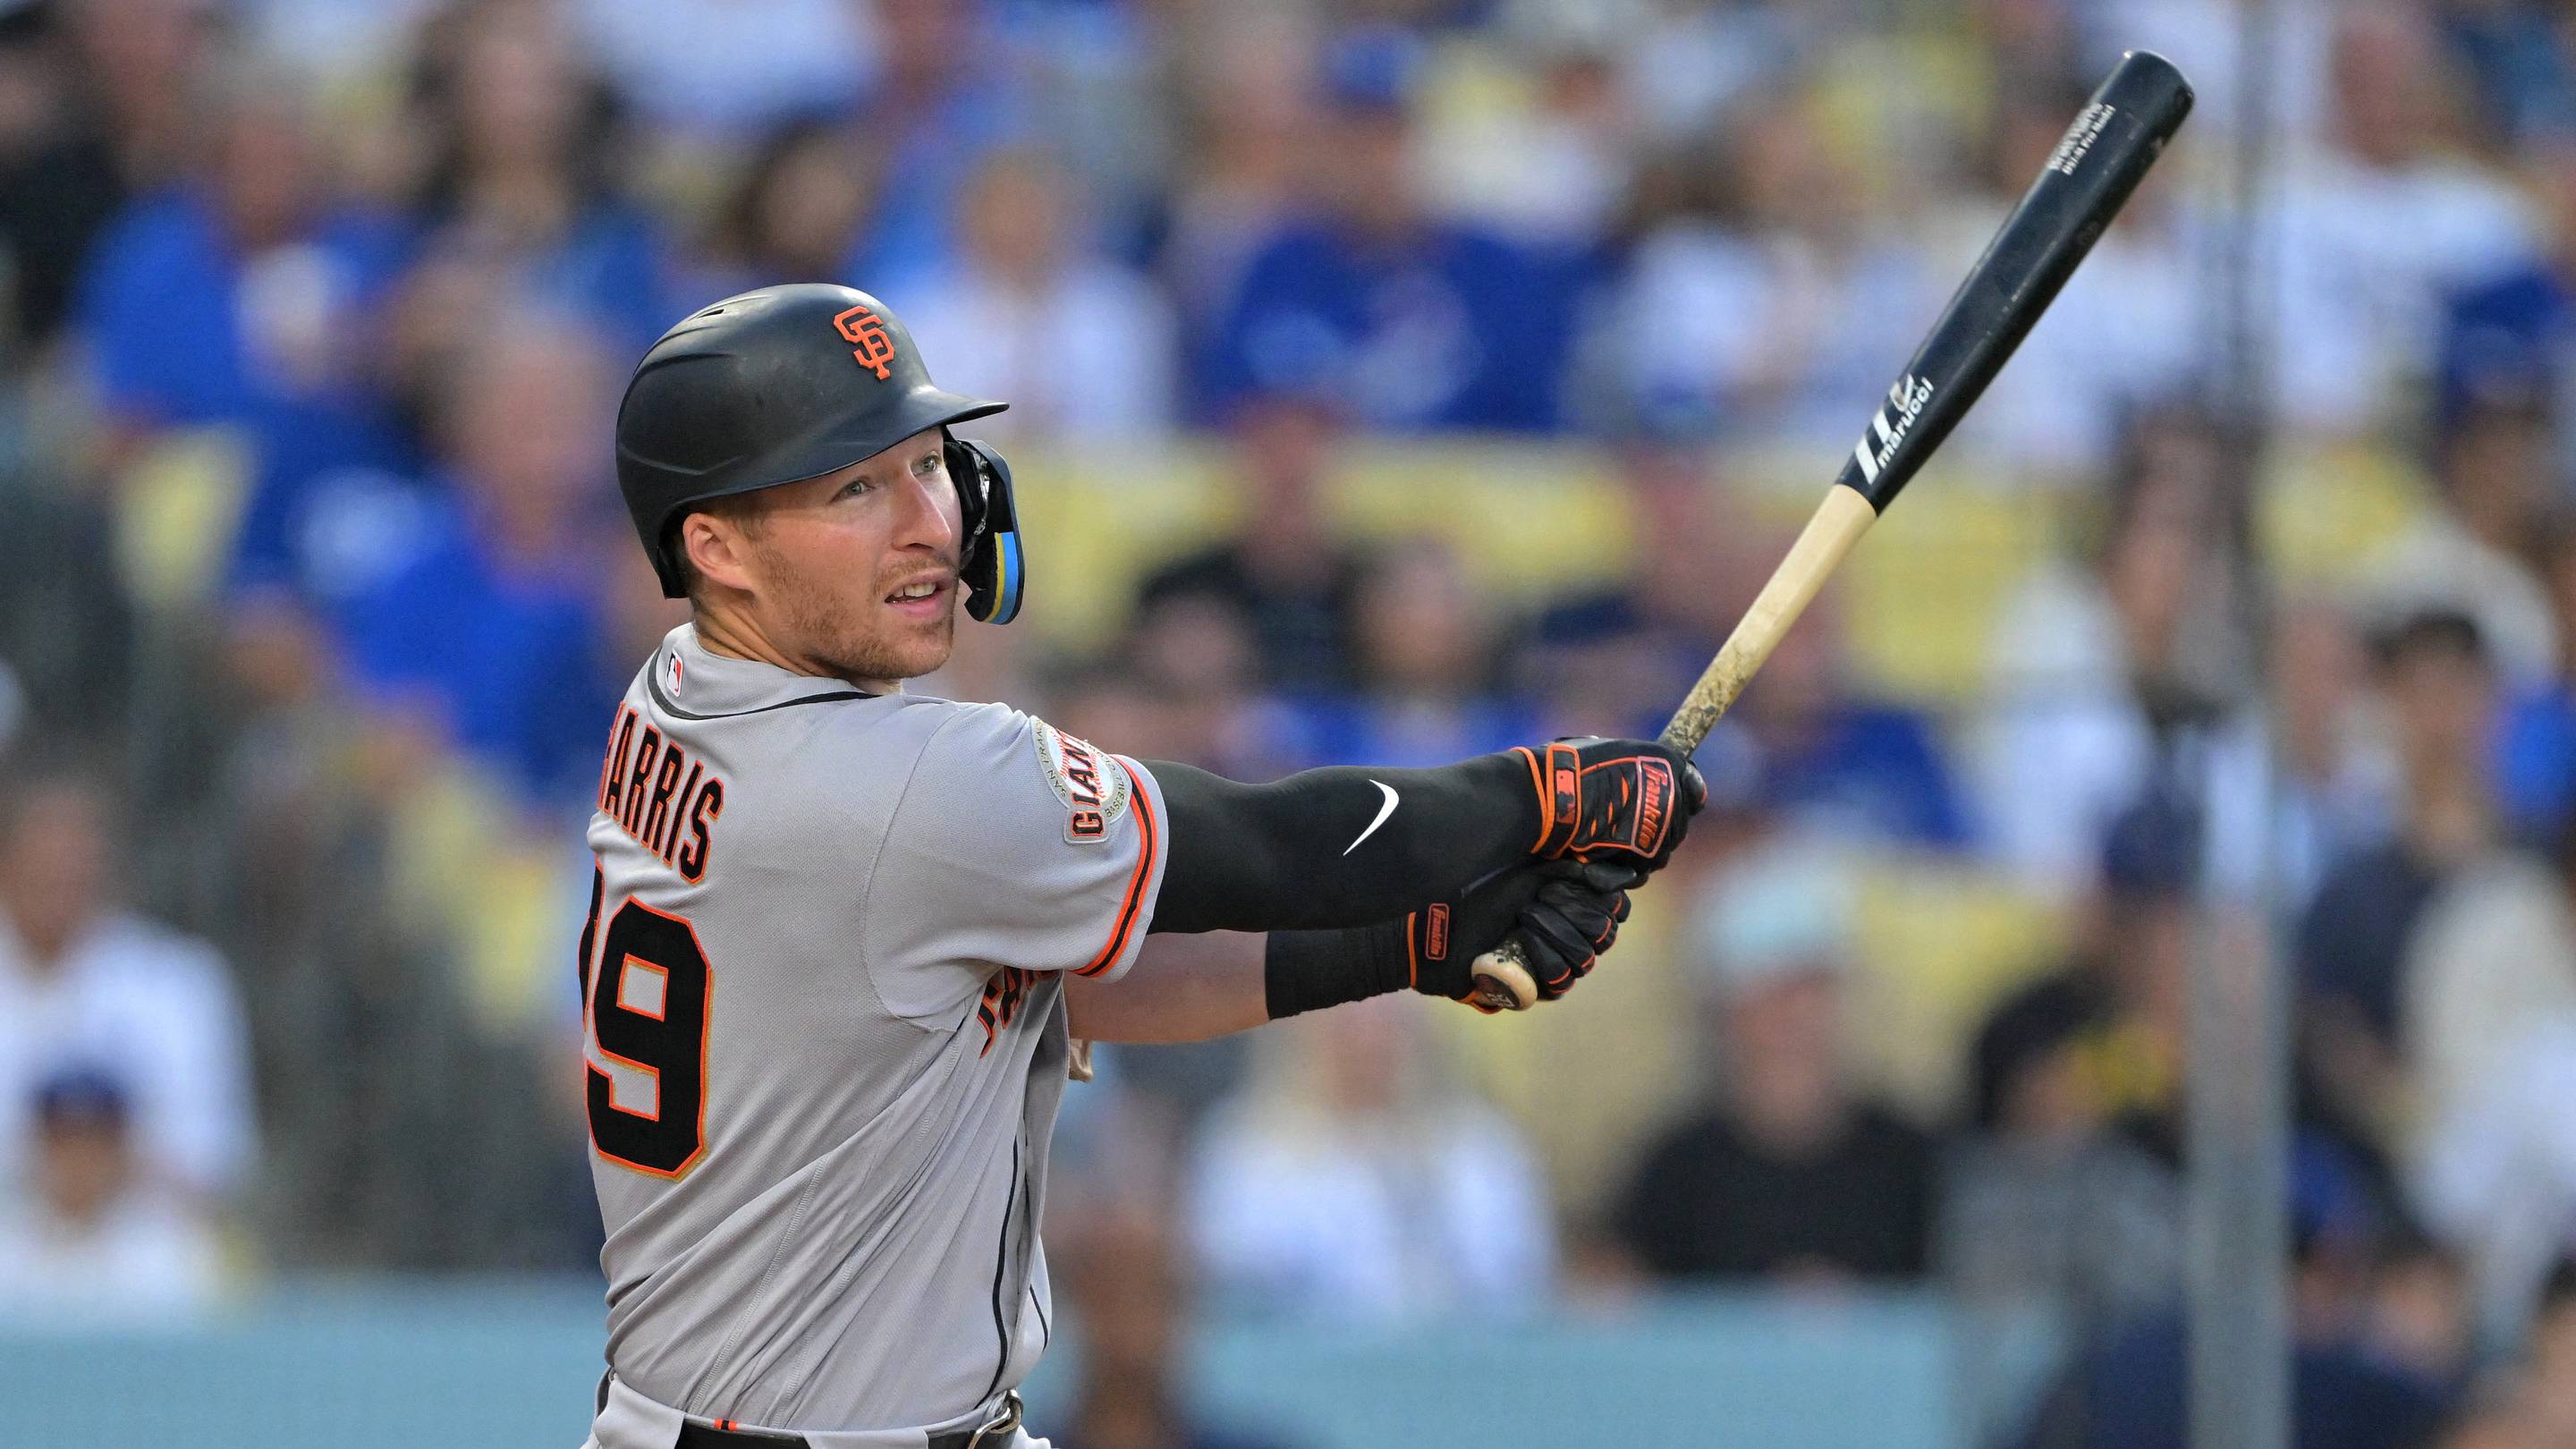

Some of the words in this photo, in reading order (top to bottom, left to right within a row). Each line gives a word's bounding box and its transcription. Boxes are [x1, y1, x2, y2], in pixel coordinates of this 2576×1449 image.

[1877, 376, 1935, 470] marucci
[597, 701, 724, 885] ARRIS
[1059, 729, 1106, 837] GIAN
[1639, 763, 1668, 850] Franklin
